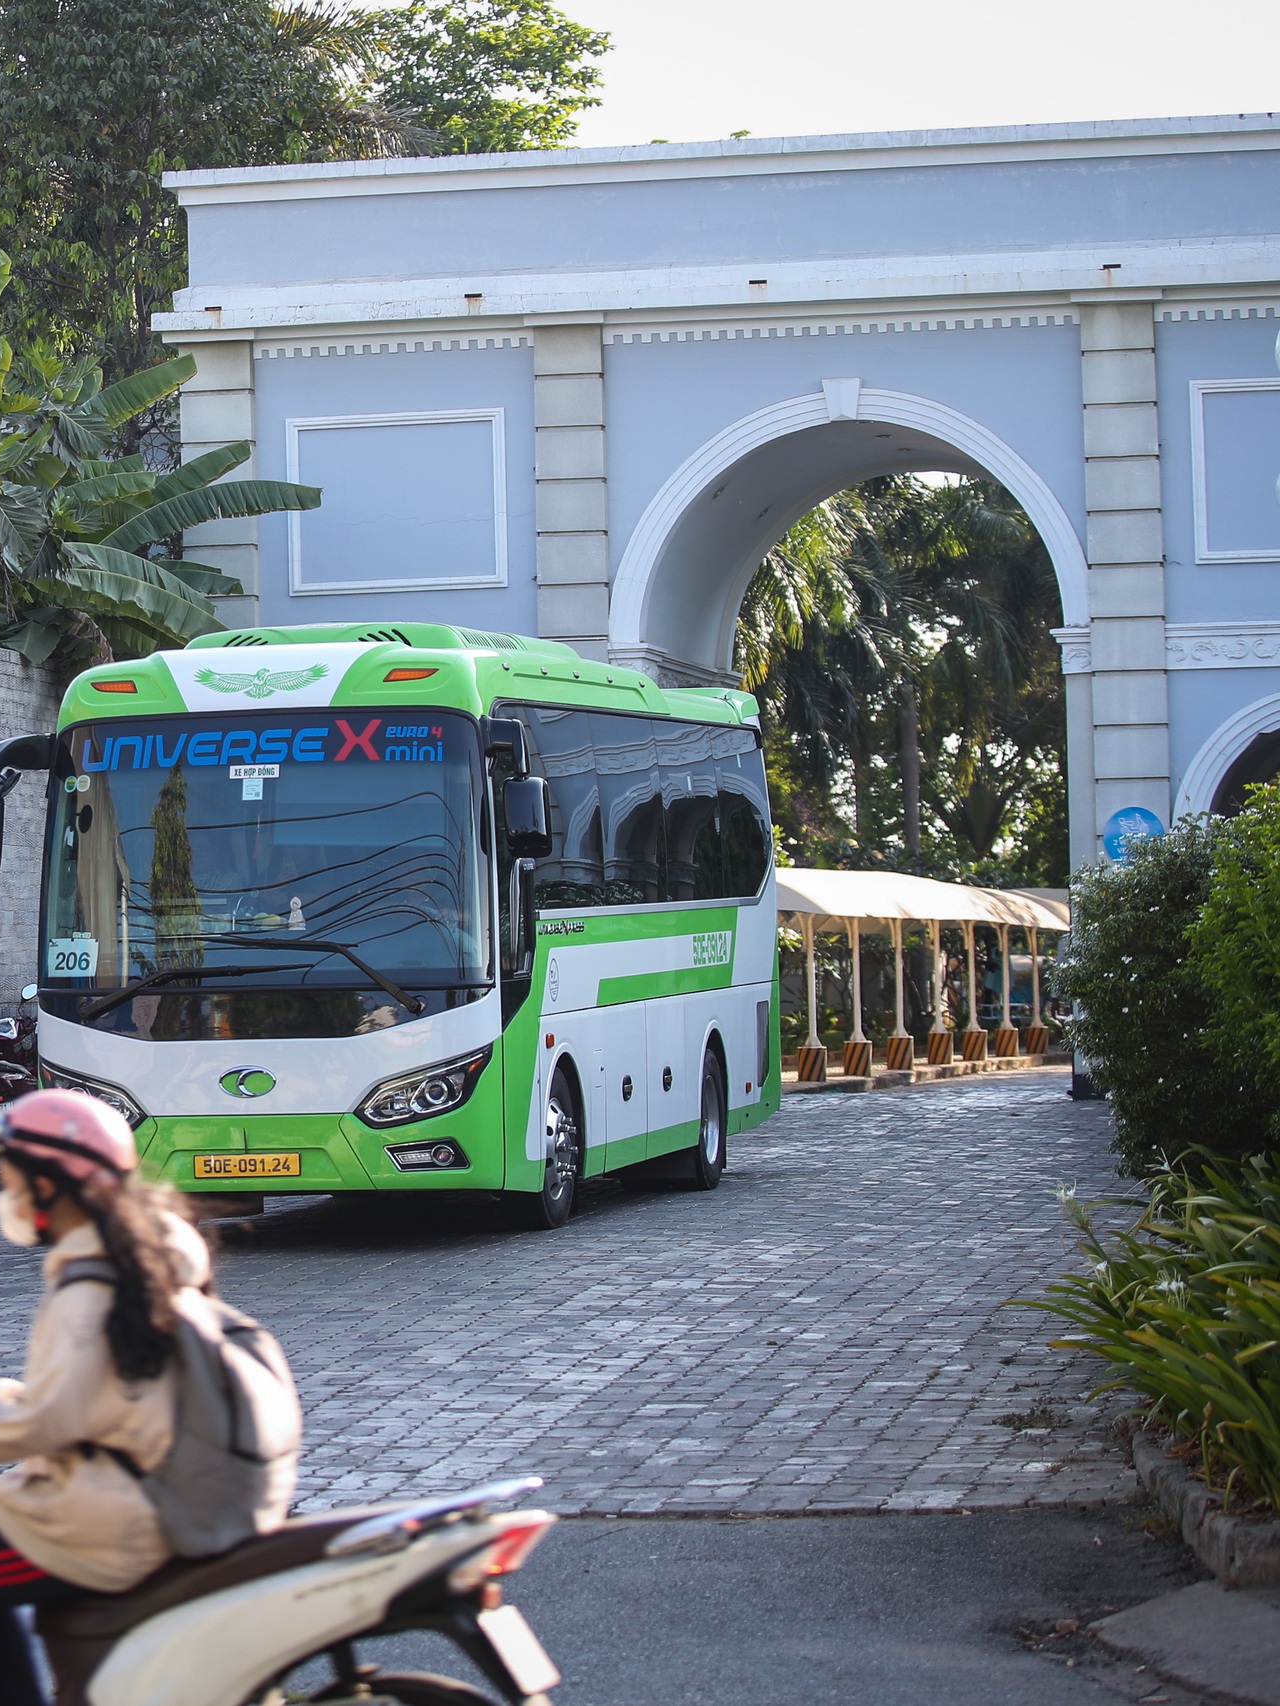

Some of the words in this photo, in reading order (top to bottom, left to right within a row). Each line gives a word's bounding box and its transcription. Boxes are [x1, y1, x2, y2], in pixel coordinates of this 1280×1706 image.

[431, 726, 443, 739] 4
[82, 727, 329, 772] UNIVERSE
[333, 719, 382, 761] X
[385, 740, 443, 762] mini
[233, 768, 242, 777] XE
[54, 951, 91, 971] 206
[203, 1157, 291, 1174] 50E-091.24
